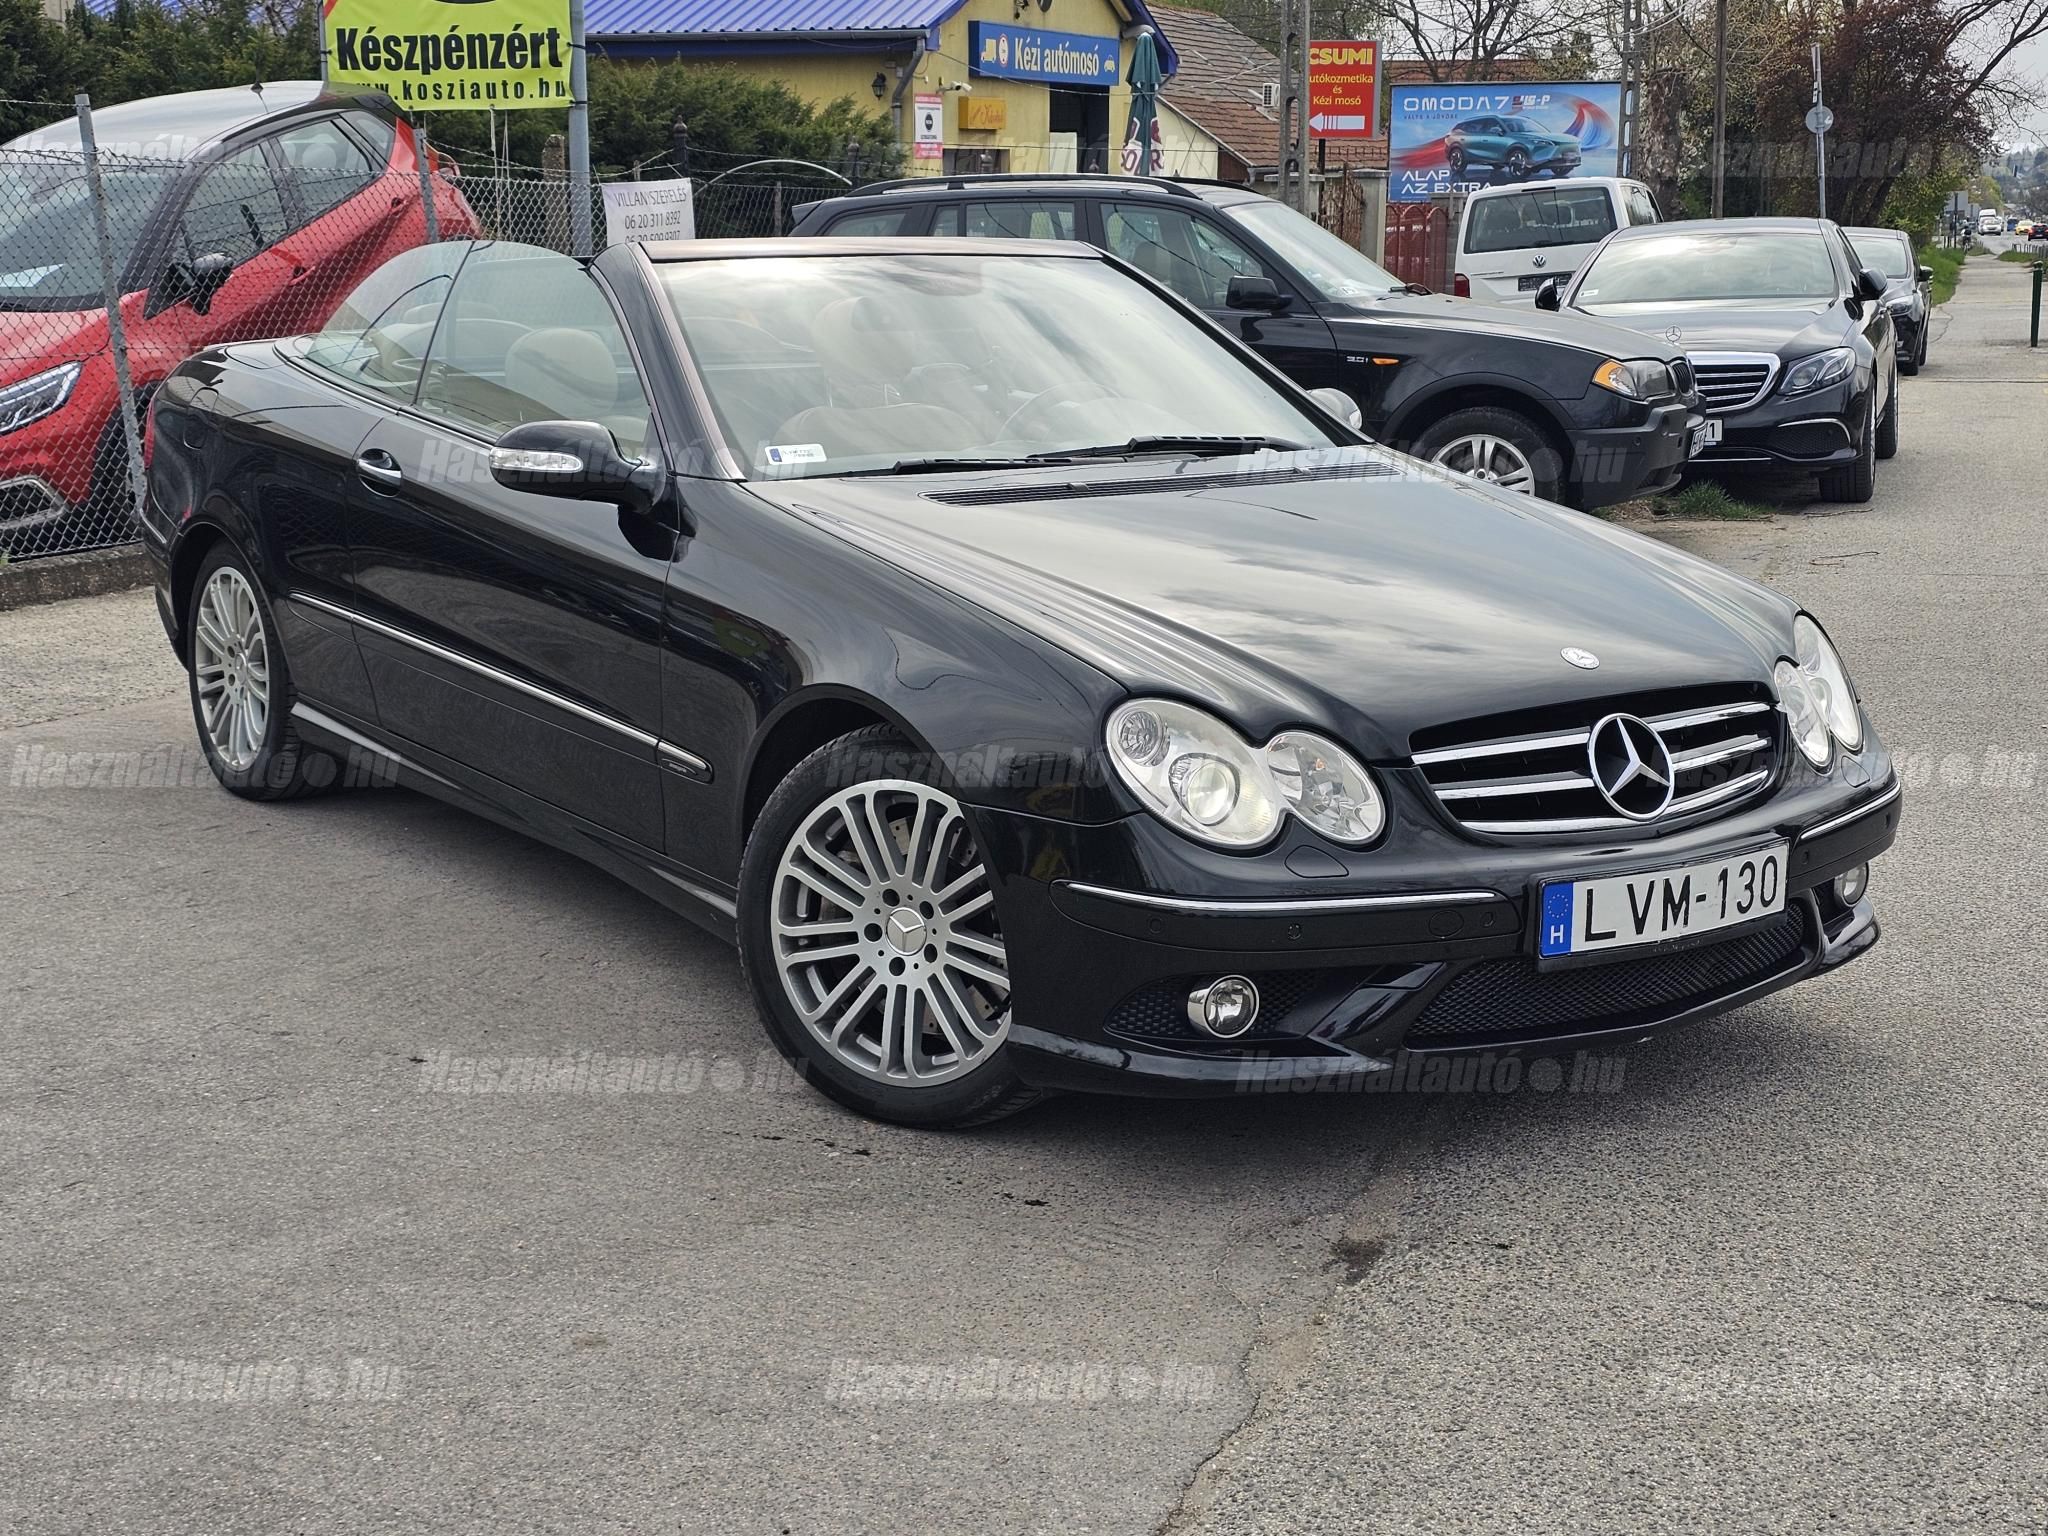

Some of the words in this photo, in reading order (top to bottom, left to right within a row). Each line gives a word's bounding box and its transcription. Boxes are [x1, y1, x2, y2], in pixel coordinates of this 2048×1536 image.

[336, 24, 563, 75] Készpénzért
[1014, 36, 1041, 71] Kézi
[1043, 40, 1099, 77] autómosó
[1309, 73, 1373, 83] utókozmetika
[1332, 85, 1343, 94] és
[1313, 96, 1332, 105] Kézi
[1335, 96, 1362, 105] mosó
[1495, 96, 1510, 110] 7
[1401, 170, 1450, 181] ALAP
[1401, 183, 1428, 194] AZ
[624, 215, 636, 229] 06
[638, 214, 649, 228] 20
[650, 213, 663, 228] 311
[665, 210, 681, 226] 8392
[1585, 855, 1778, 942] LVM-130
[1550, 924, 1564, 945] H
